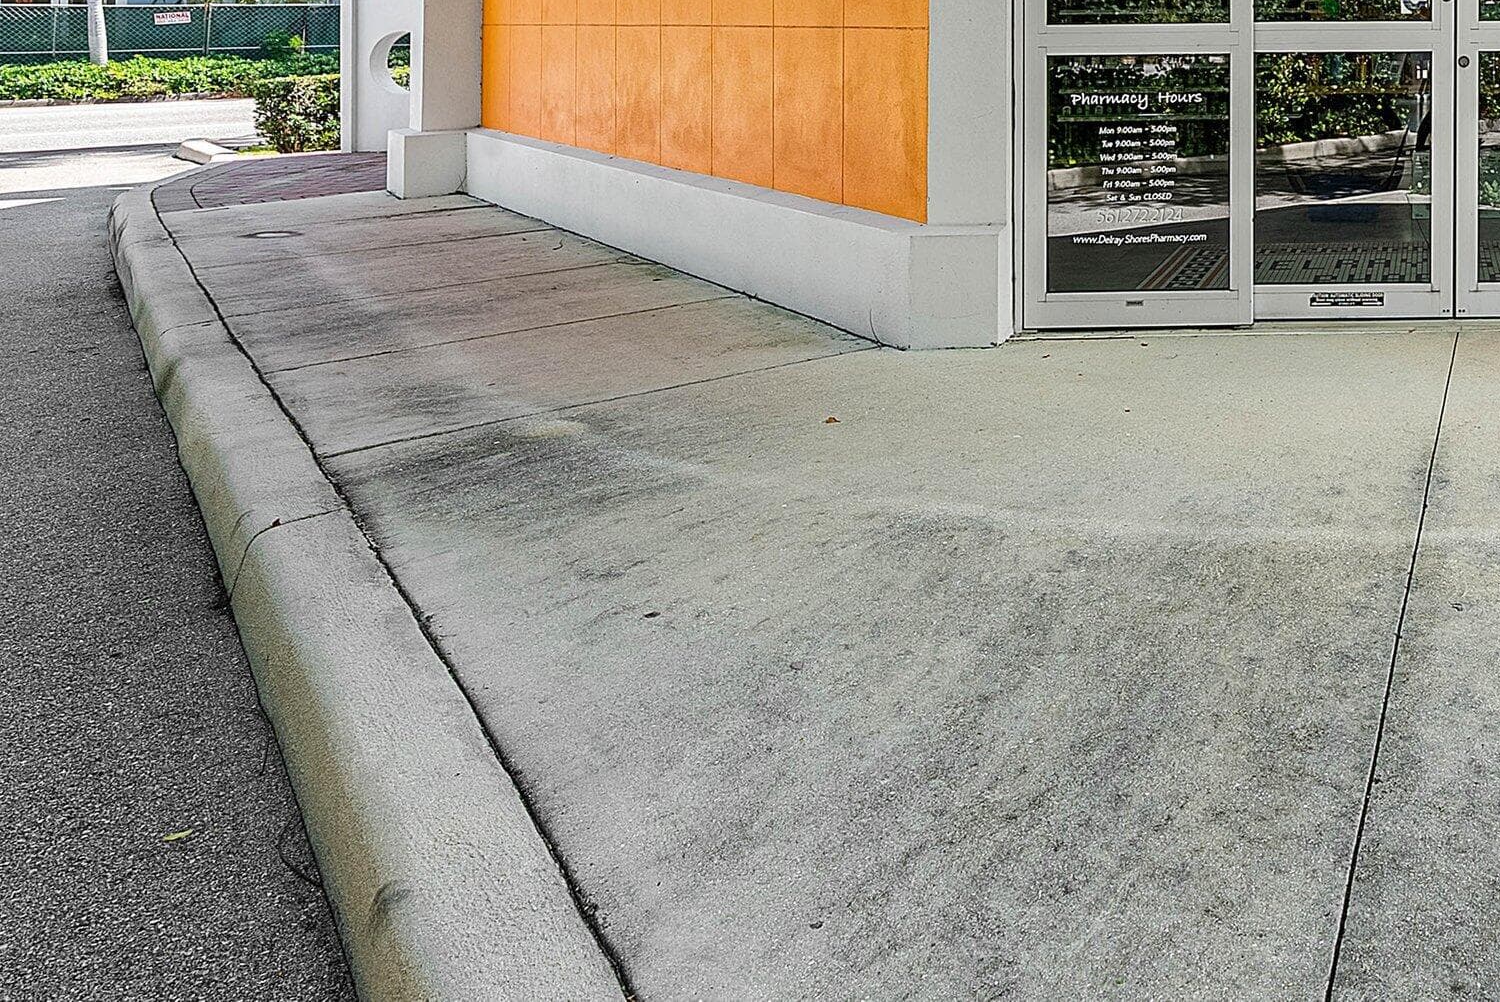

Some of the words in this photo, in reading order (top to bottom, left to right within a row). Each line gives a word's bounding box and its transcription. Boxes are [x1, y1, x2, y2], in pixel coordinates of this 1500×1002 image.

[1070, 92, 1148, 110] Pharmacy
[1158, 92, 1203, 104] Hours
[1099, 126, 1115, 134] Mon
[1101, 140, 1113, 148] Tue
[1100, 153, 1116, 161] Wed
[1101, 167, 1114, 175] Thu
[1103, 180, 1113, 188] Fri
[1143, 192, 1173, 201] CLOSED
[1097, 207, 1183, 223] 561.272.2124
